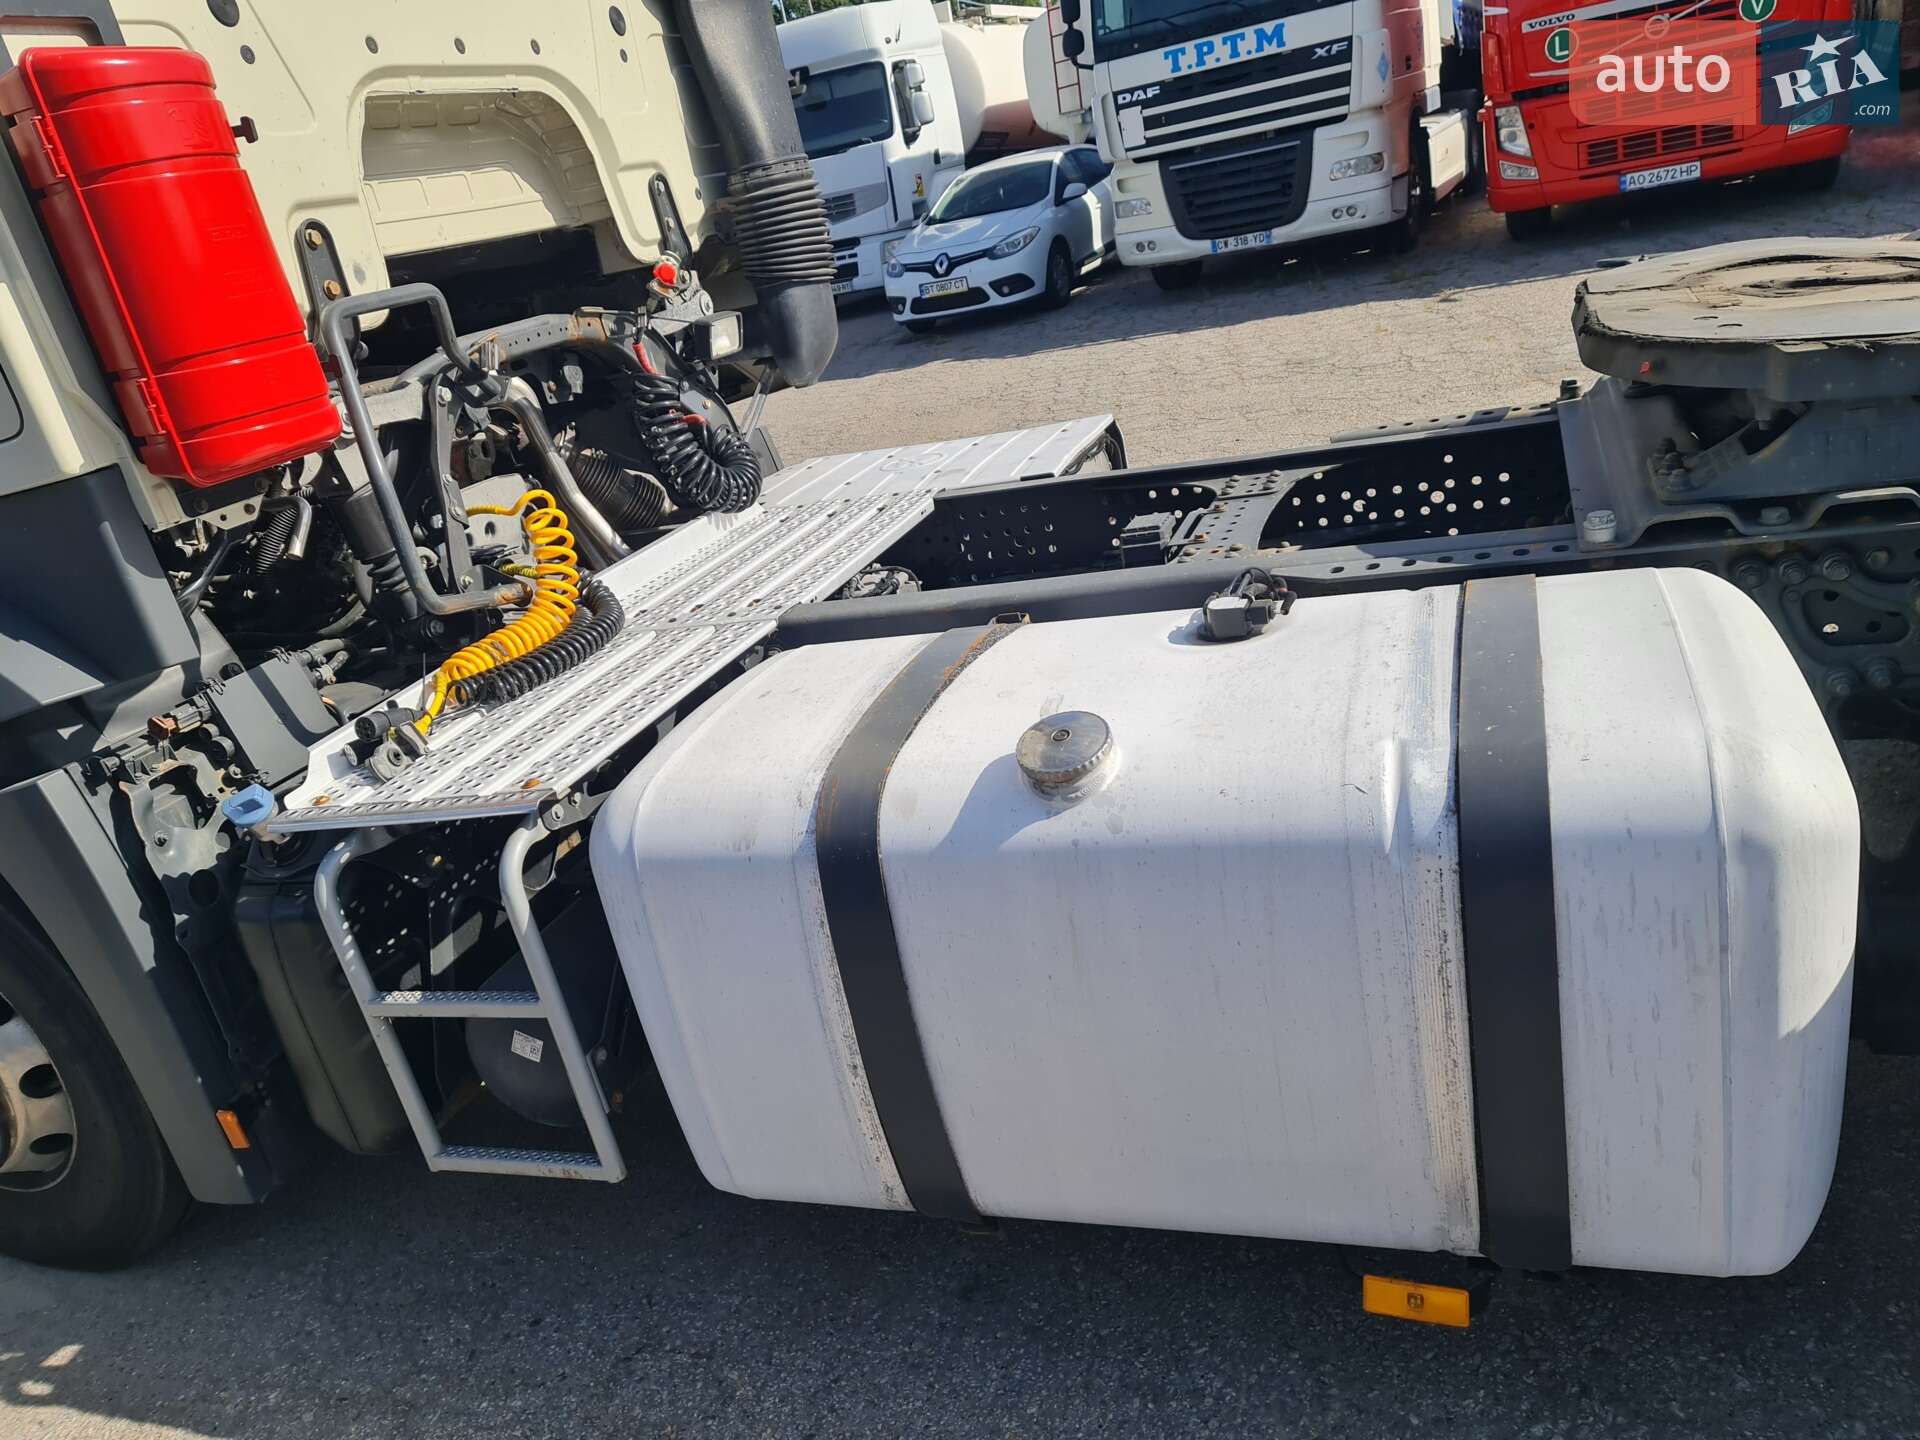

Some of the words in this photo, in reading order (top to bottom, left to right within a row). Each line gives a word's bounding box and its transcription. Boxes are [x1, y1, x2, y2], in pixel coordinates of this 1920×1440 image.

[1528, 13, 1576, 29] VOLVO
[1164, 22, 1286, 74] T.P.T.M
[1311, 41, 1349, 59] XF
[1554, 36, 1569, 56] L
[1117, 86, 1161, 104] DAF
[1628, 174, 1646, 187] AO
[1647, 168, 1678, 183] 2672
[1679, 164, 1698, 177] HP
[954, 280, 965, 289] CT
